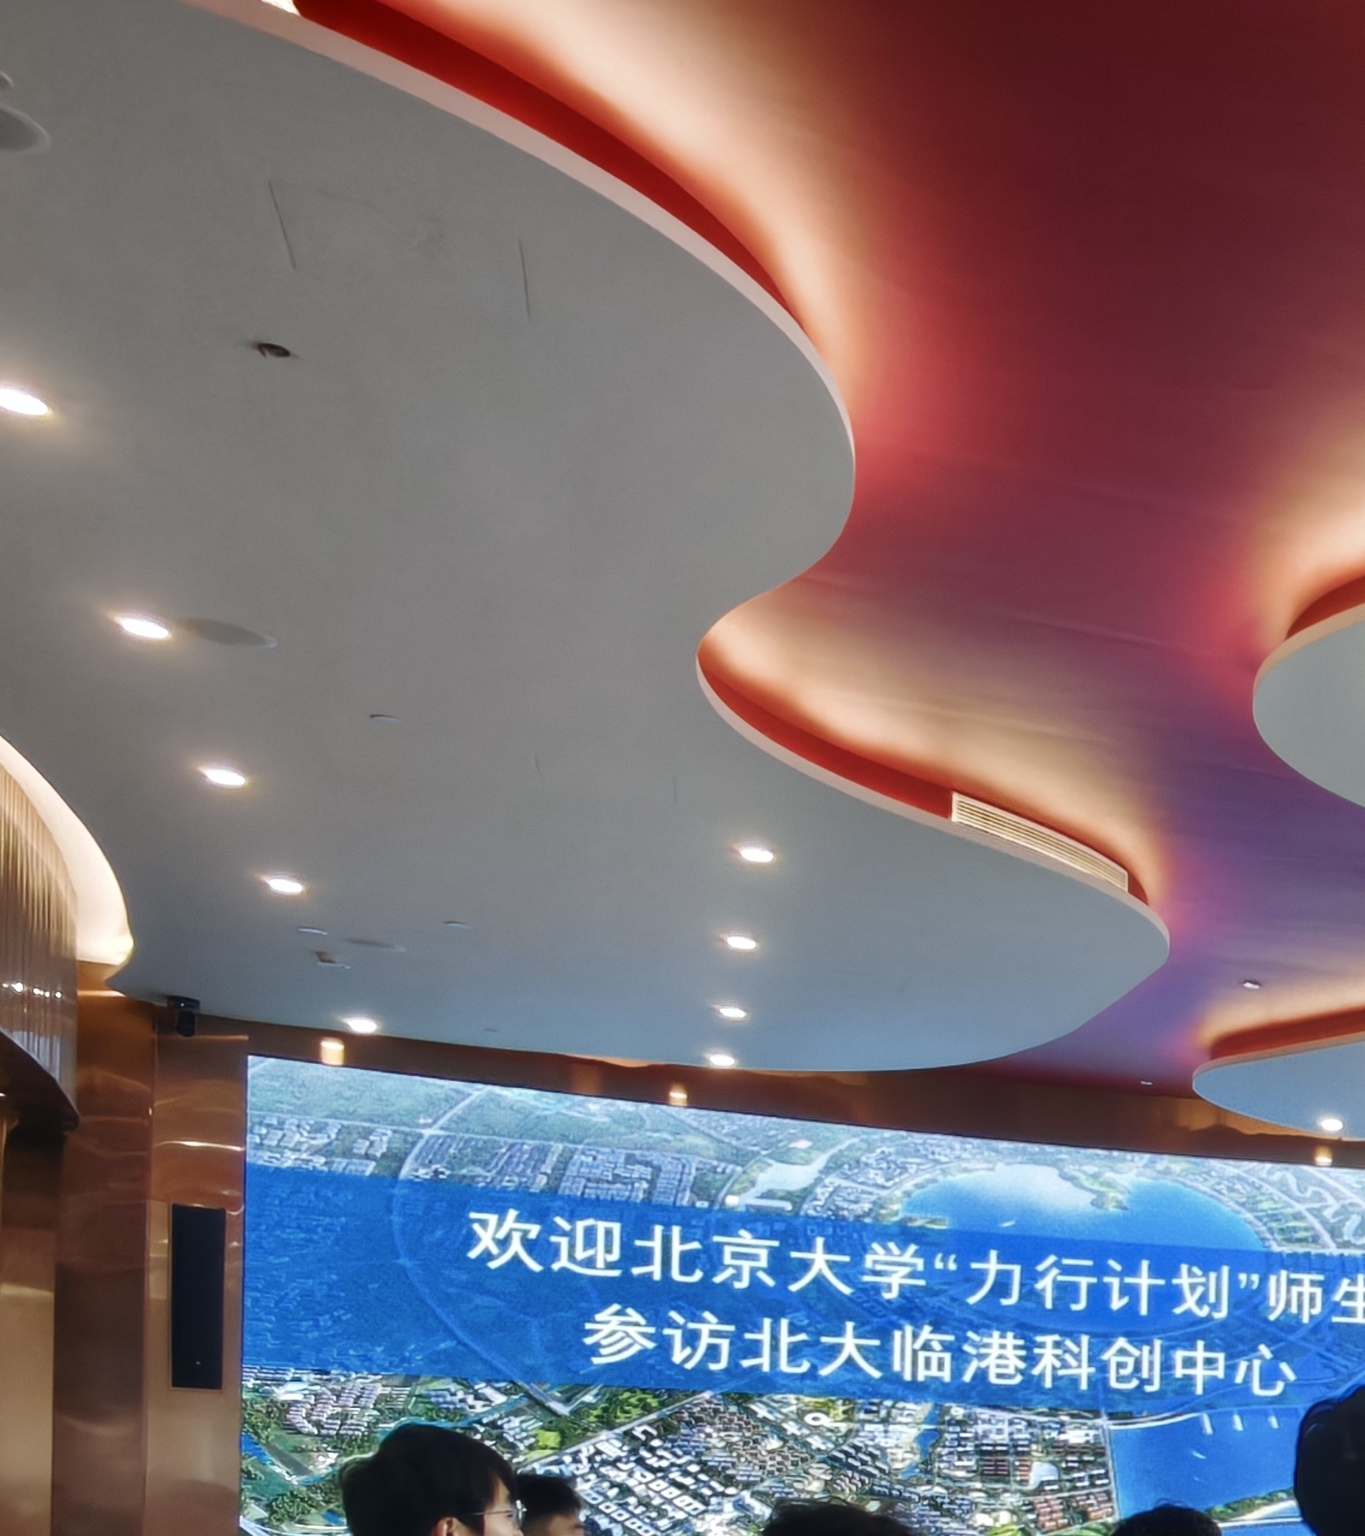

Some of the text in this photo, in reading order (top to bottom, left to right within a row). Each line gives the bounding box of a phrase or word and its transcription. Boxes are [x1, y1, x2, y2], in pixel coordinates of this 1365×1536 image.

[582, 1303, 1297, 1397] 参访北大临港科创中心
